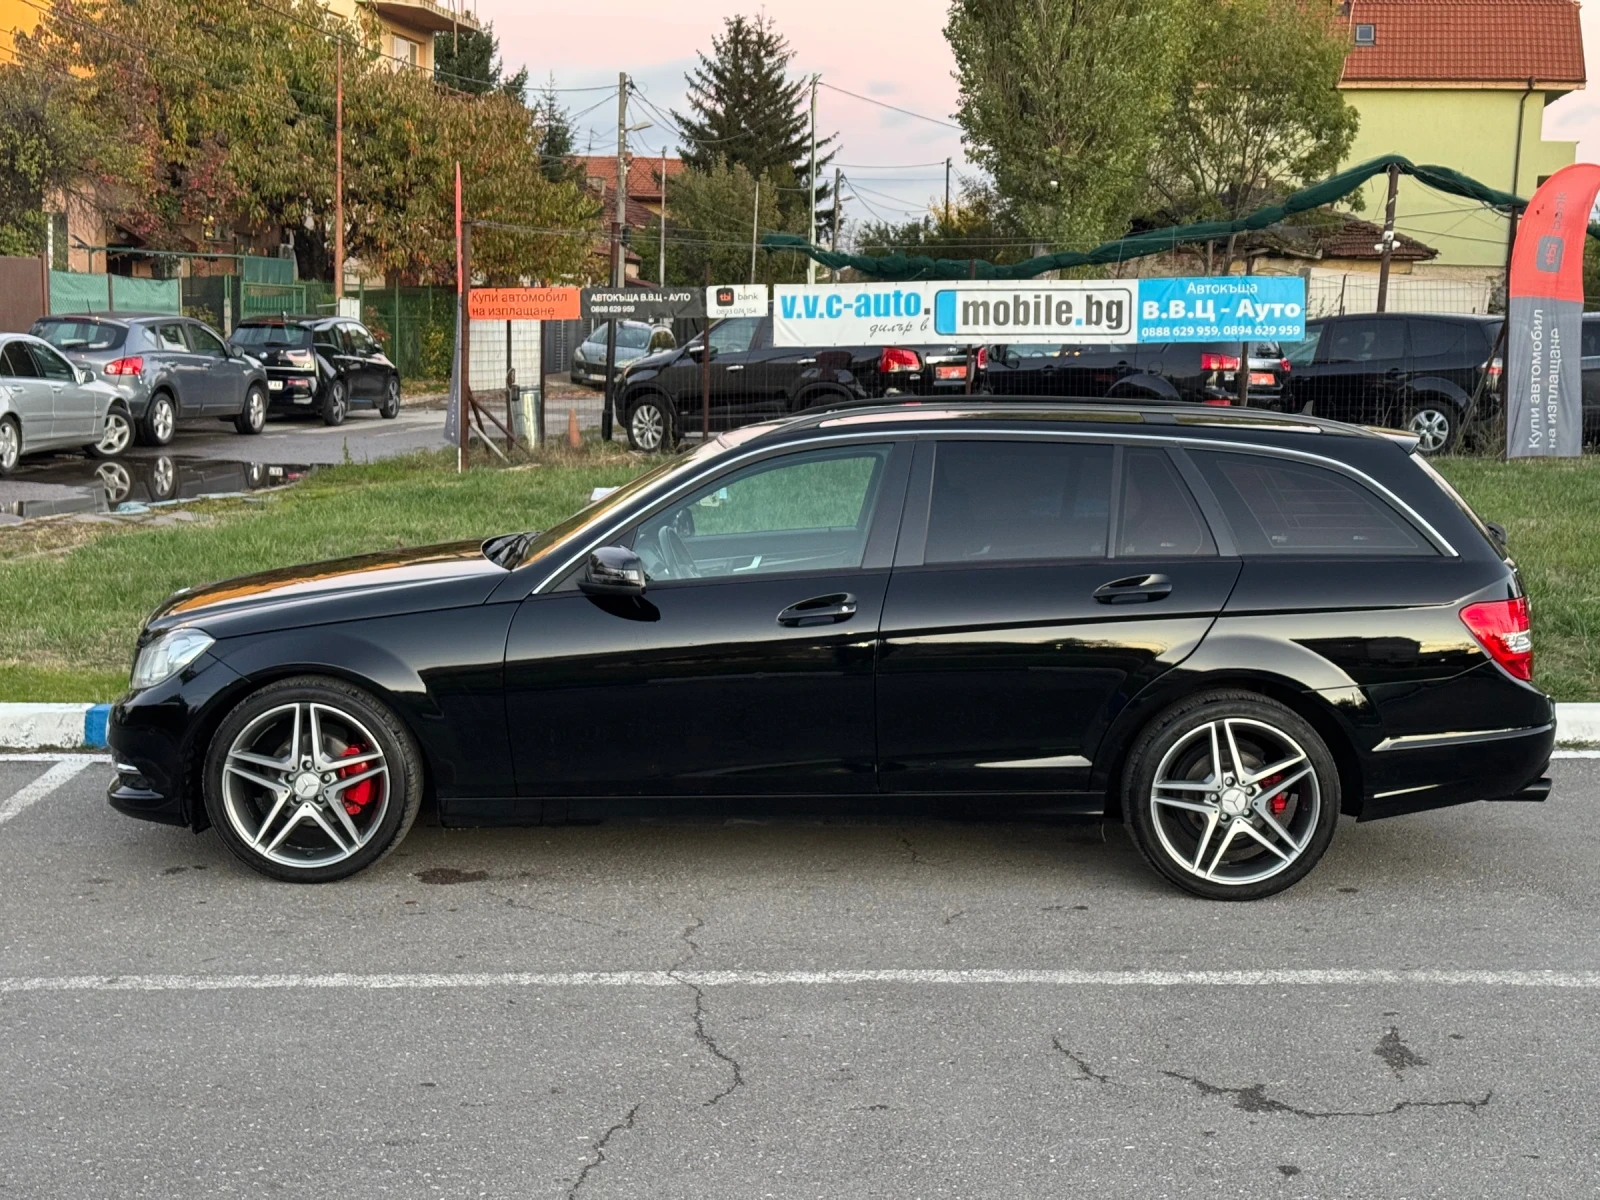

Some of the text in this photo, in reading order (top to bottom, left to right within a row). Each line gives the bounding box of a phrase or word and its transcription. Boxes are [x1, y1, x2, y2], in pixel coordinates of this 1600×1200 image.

[1546, 191, 1567, 266] tbi bank
[1186, 282, 1258, 295] Автокъща
[471, 292, 567, 304] Купи автомобил
[590, 293, 639, 303] АВТОКЪЩА
[640, 293, 663, 302] В.В.Ц
[668, 293, 691, 301] АУТО
[719, 292, 758, 301] tbi bank
[472, 307, 555, 316] на изплащане
[590, 305, 608, 313] 0888
[962, 294, 1124, 330] mobile.bg
[1142, 299, 1215, 322] В.В.Ц
[1236, 298, 1301, 322] Ауто
[869, 317, 930, 337] дилър в
[1141, 325, 1300, 337] 0888 629 959, 0894 629 959
[1528, 309, 1543, 449] Купи автомобил
[1548, 328, 1562, 449] на изплащане
